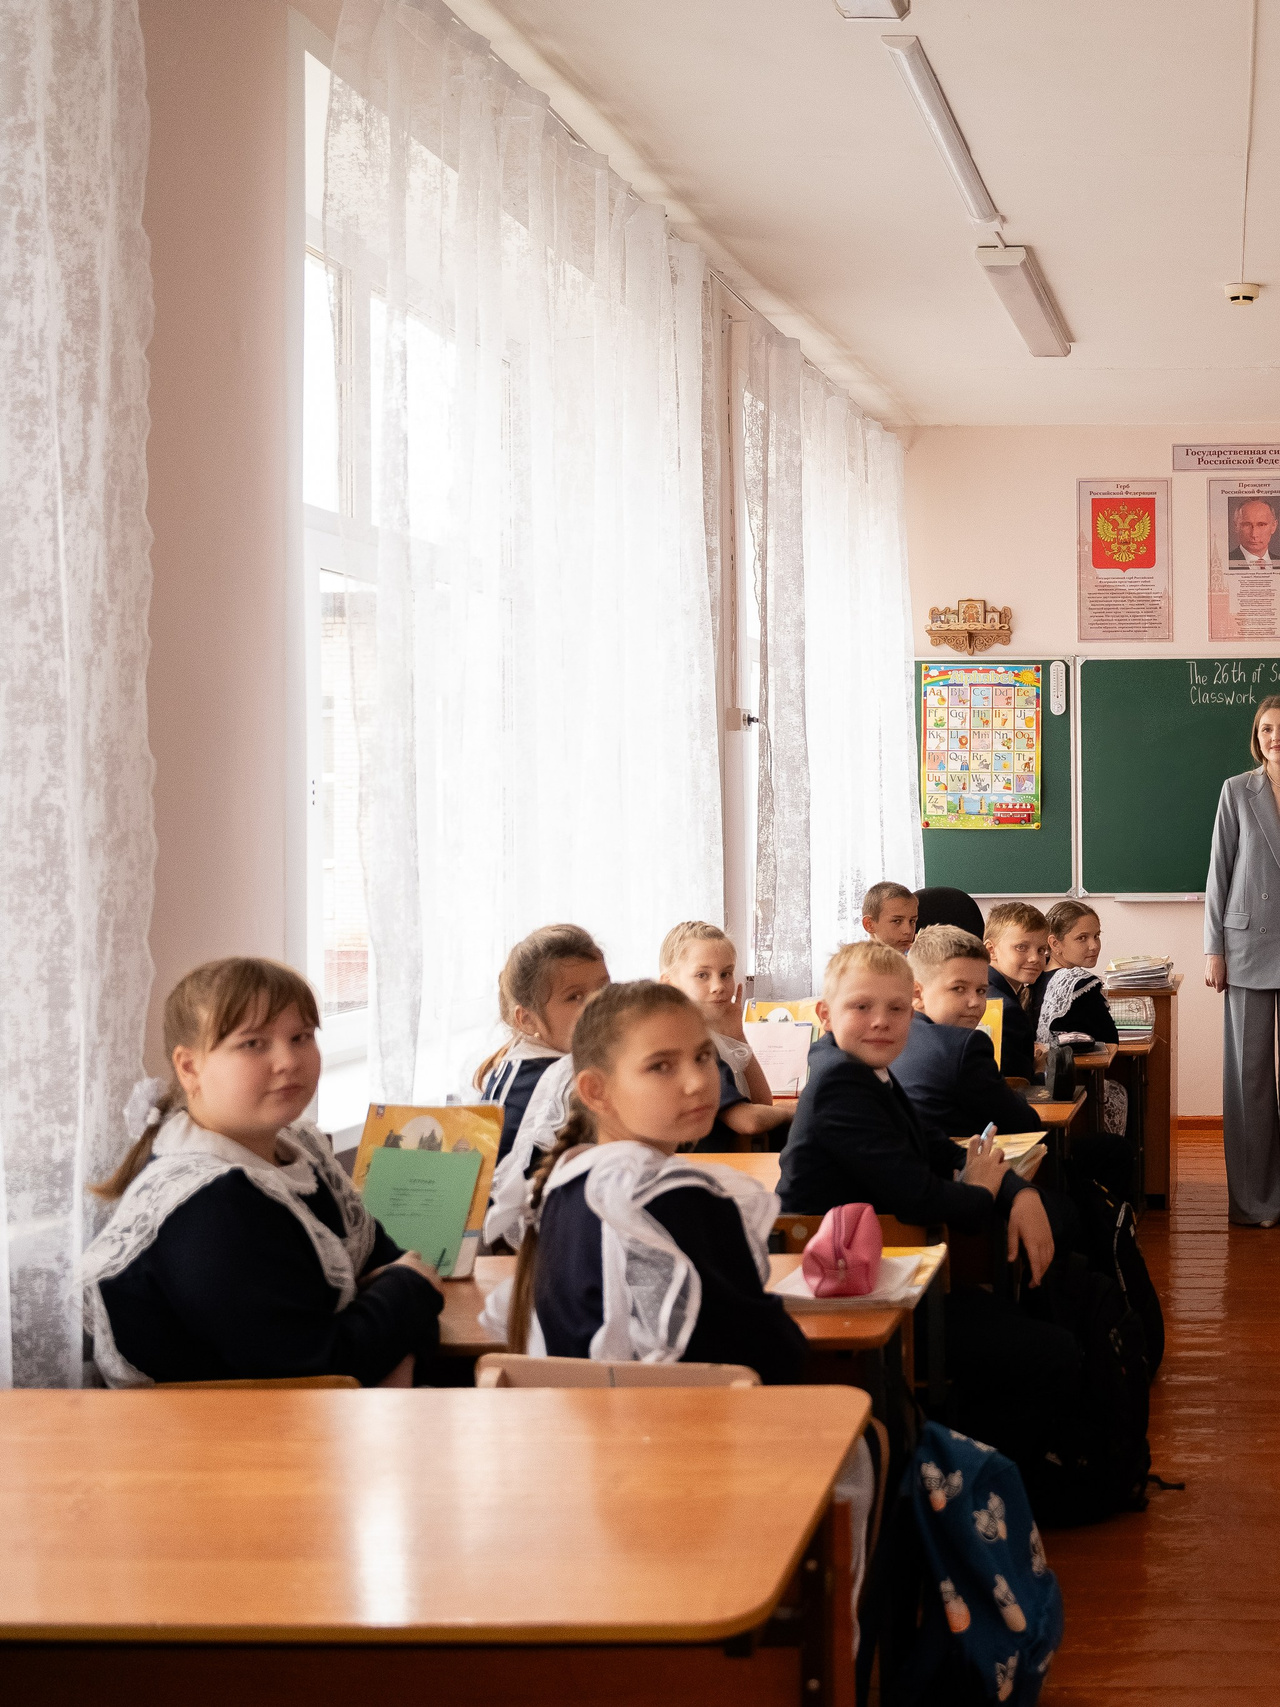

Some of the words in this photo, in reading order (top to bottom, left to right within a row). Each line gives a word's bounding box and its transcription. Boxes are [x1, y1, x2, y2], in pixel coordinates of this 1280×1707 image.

[1185, 448, 1267, 458] Государственная
[1197, 457, 1254, 466] Российской
[1116, 483, 1130, 491] Герб
[1238, 482, 1271, 490] Президент
[1124, 490, 1157, 498] Федерации
[1185, 661, 1208, 686] The
[1213, 661, 1246, 685] 26th
[1252, 663, 1265, 683] of
[949, 669, 1016, 688] Alphabet
[928, 687, 943, 696] Aa
[950, 687, 965, 697] Bb
[972, 687, 987, 697] Cc
[994, 687, 1008, 697] Dd
[1016, 687, 1030, 697] Ee
[1190, 684, 1257, 705] Classwork
[928, 709, 938, 718] Ff
[949, 709, 964, 720] Gg
[972, 709, 987, 718] Hh
[1016, 709, 1026, 720] Jj
[928, 730, 941, 739] Kk
[972, 730, 990, 739] Mm
[994, 730, 1008, 739] Nn
[1015, 730, 1030, 739] Oo
[928, 752, 940, 762] Pp
[949, 752, 962, 763] Qq
[972, 752, 983, 761] Rr
[994, 752, 1007, 761] Ss
[1016, 752, 1026, 761] Tt
[927, 773, 941, 782] Uu
[950, 774, 964, 783] Vv
[971, 774, 986, 783] Ww
[993, 774, 1006, 783] Xx
[928, 795, 939, 804] Zz
